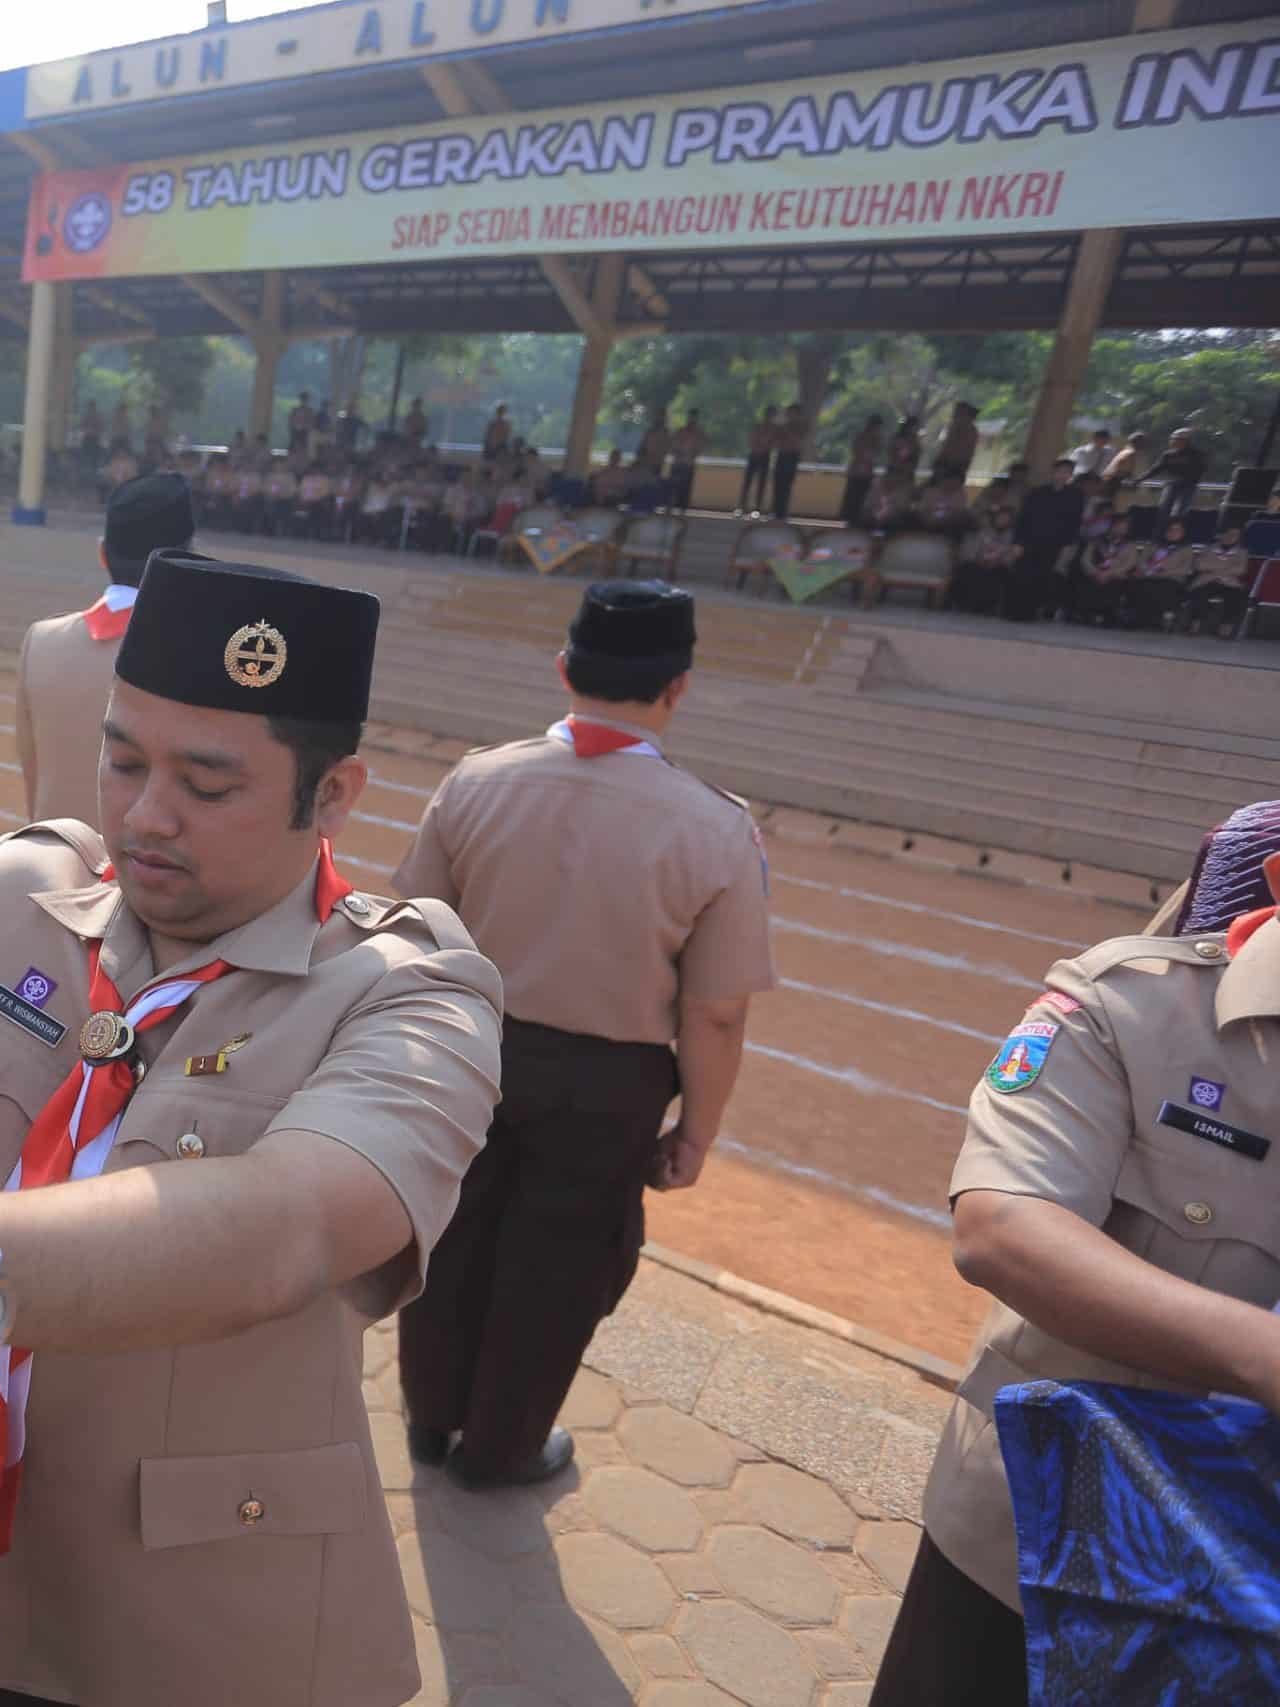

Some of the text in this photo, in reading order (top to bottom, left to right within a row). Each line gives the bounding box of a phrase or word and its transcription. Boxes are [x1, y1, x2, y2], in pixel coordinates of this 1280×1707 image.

[72, 39, 229, 104] ALUN
[121, 173, 174, 217] 58
[183, 148, 350, 209] TAHUN
[358, 113, 656, 192] GERAKAN
[665, 63, 1097, 167] PRAMUKA
[392, 171, 1065, 250] SIAP SEDIA MEMBANGUN KEUTUHAN NKRI
[1193, 1120, 1236, 1144] ISMAIL
